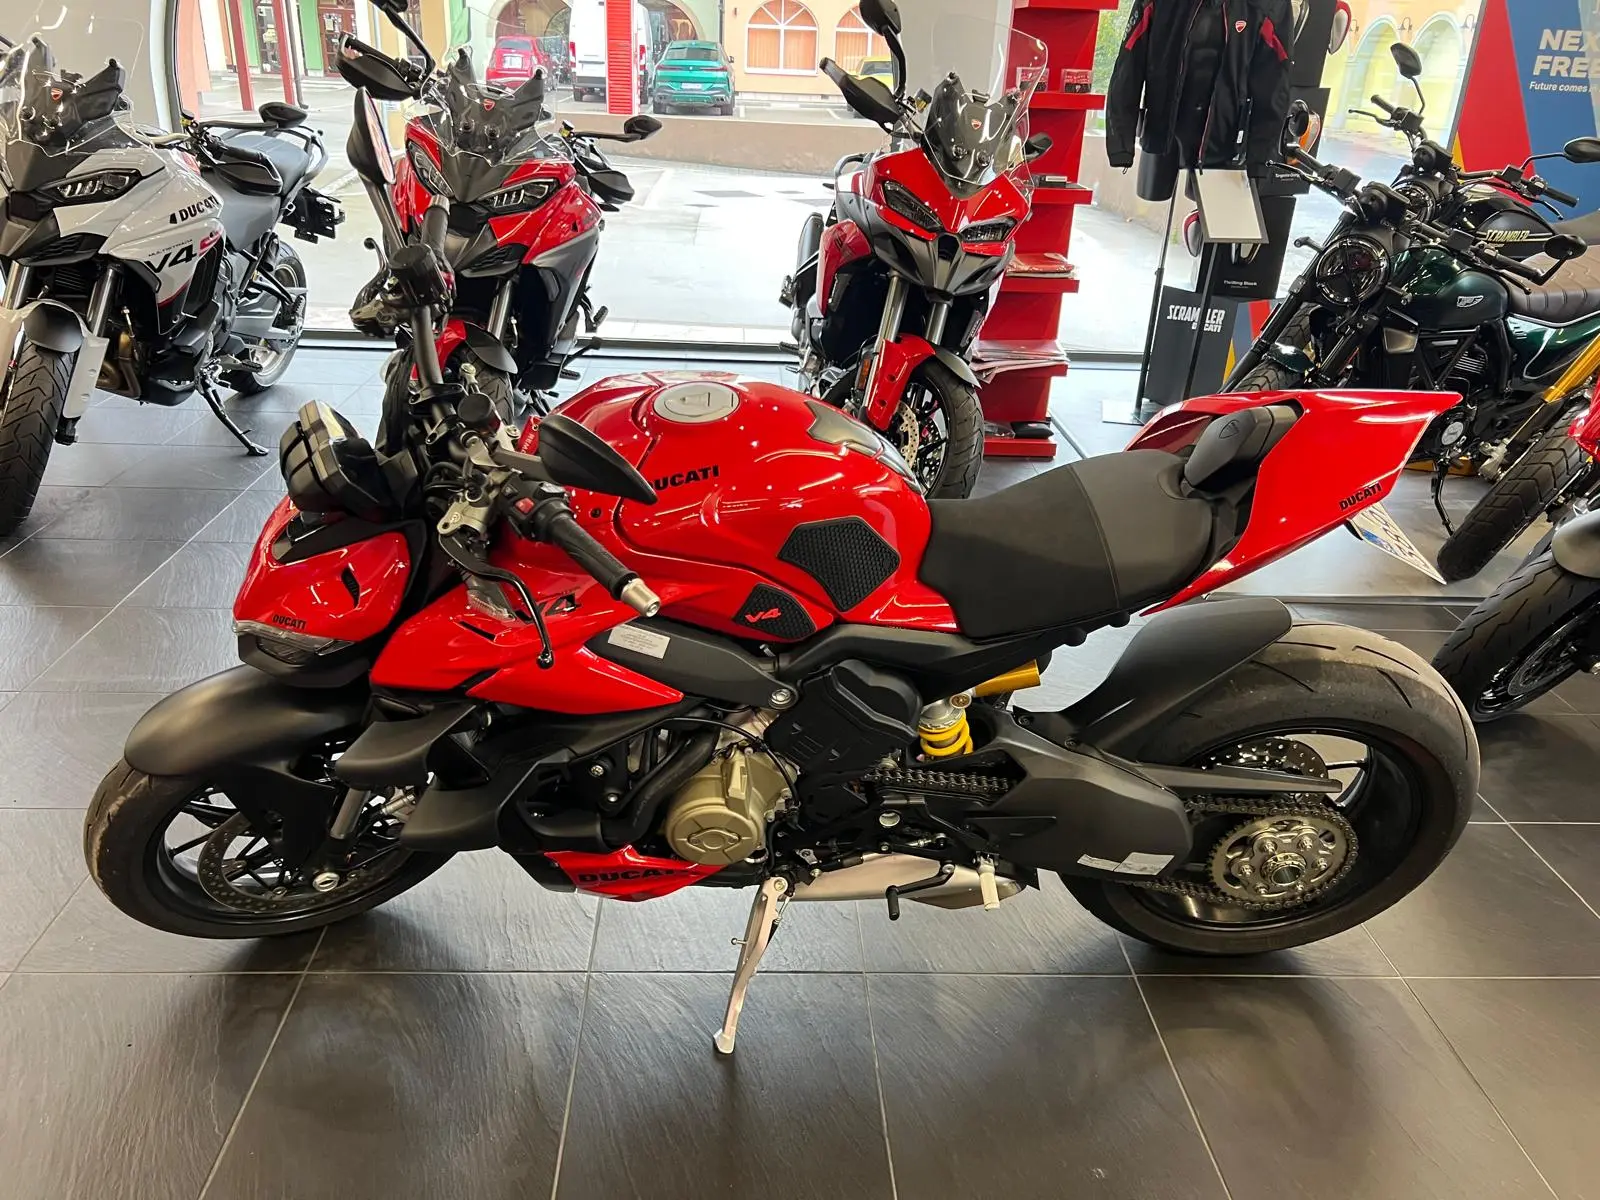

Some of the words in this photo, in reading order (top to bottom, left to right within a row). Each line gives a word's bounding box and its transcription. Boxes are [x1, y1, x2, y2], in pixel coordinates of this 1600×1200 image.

[1529, 81, 1557, 91] Future
[1559, 83, 1587, 92] comes
[179, 195, 219, 221] DUCATI
[1486, 229, 1530, 242] SCRAMBLER
[144, 244, 197, 273] V4
[1167, 305, 1226, 325] SCRAMLER
[1191, 322, 1222, 333] DCATI
[1338, 482, 1383, 511] DUCATI
[271, 613, 307, 631] DUCATI
[745, 607, 782, 623] V4
